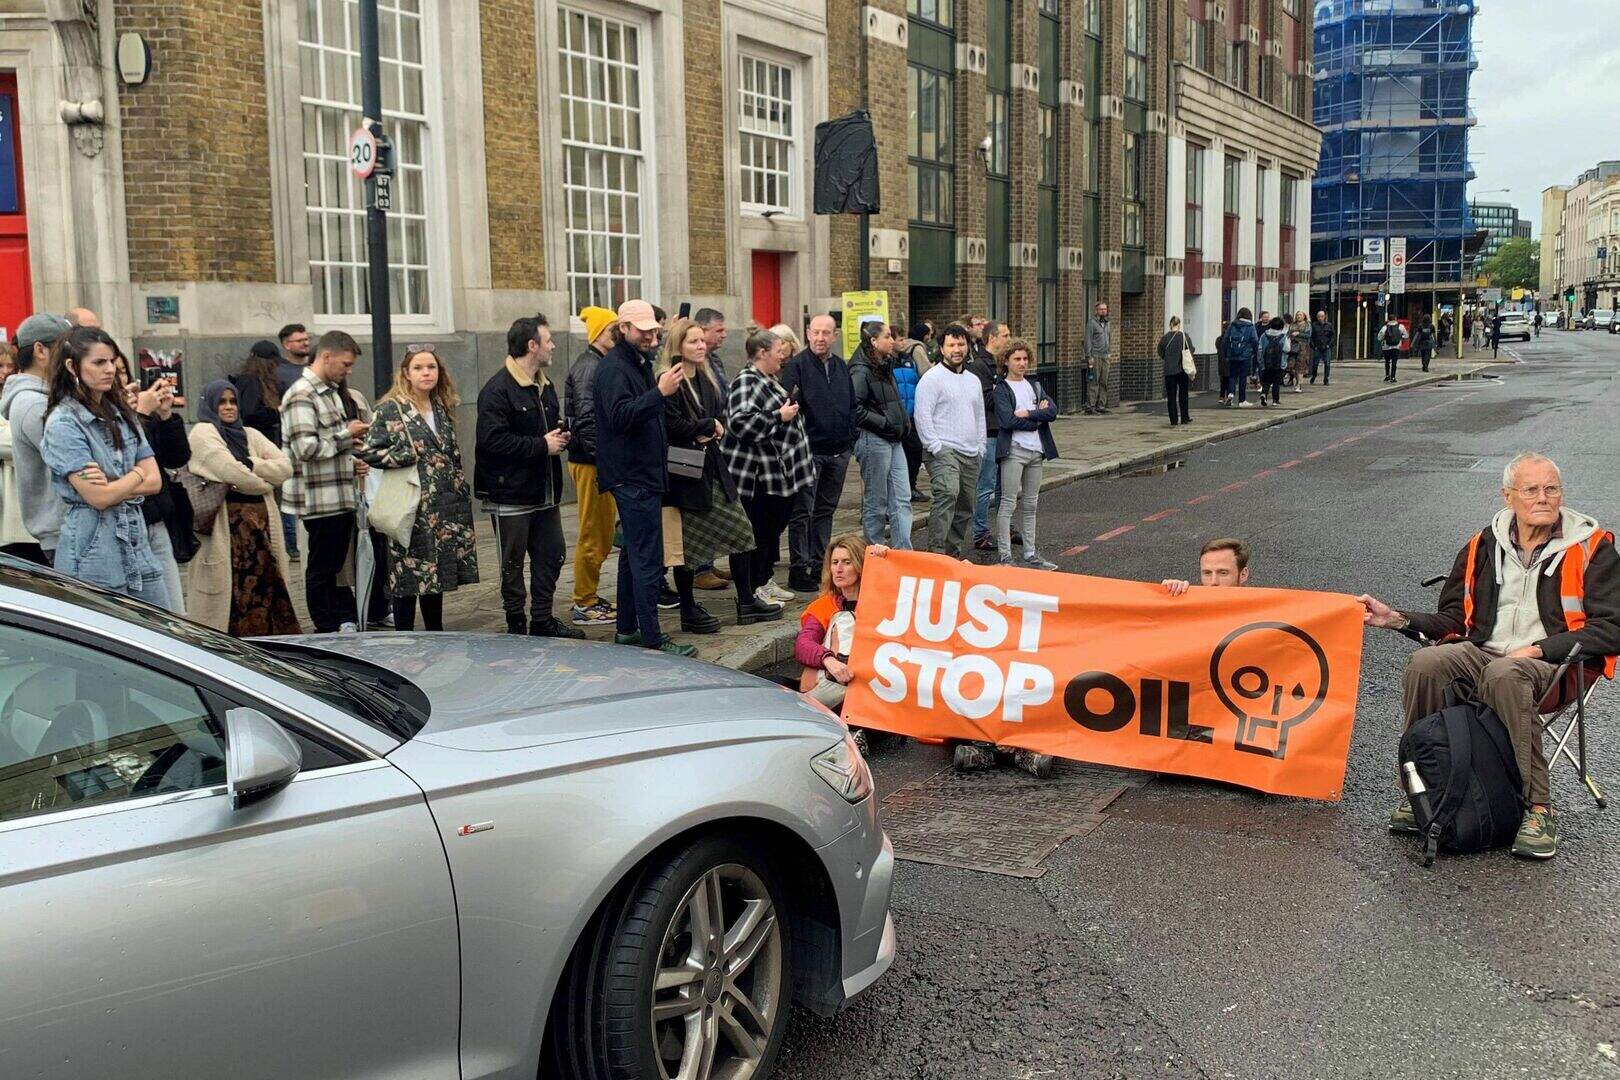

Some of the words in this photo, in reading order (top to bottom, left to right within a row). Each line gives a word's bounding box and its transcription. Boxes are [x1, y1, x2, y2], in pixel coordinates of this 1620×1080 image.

[352, 142, 371, 164] 20
[875, 576, 1060, 653] JUST
[869, 641, 1054, 723] STOP
[1063, 671, 1214, 744] OIL
